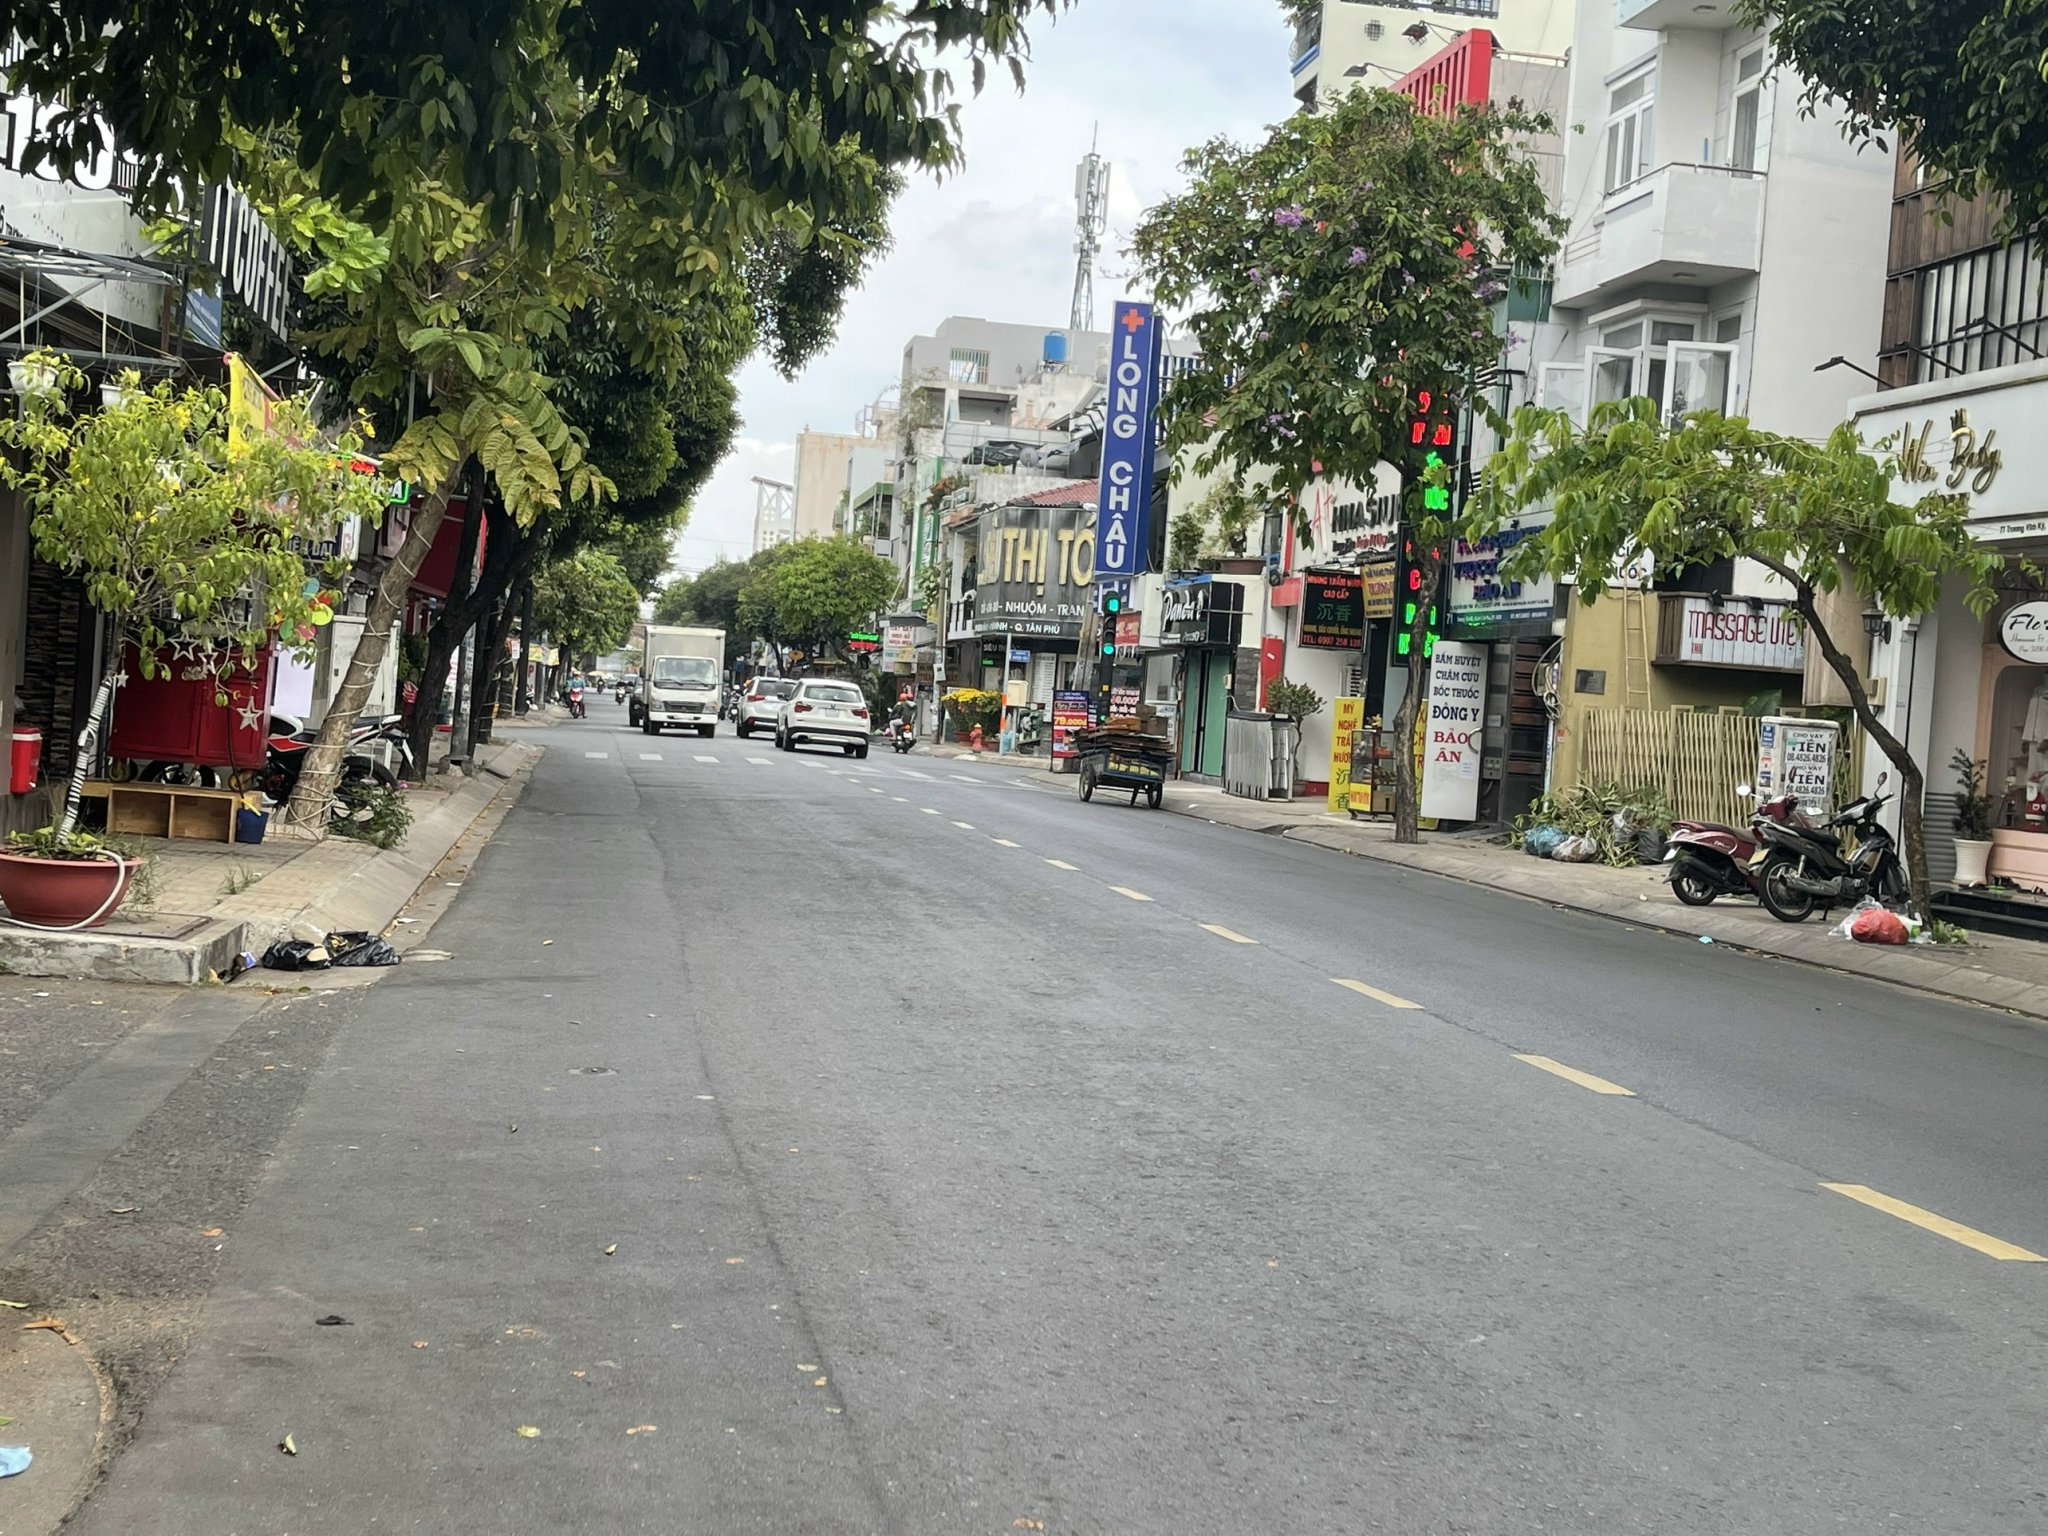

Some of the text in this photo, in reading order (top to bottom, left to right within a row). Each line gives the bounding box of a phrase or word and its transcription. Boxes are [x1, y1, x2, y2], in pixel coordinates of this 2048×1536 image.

[1112, 335, 1142, 439] LONG
[1105, 461, 1134, 569] CHÂU
[1003, 527, 1049, 597] THỊ
[1005, 600, 1047, 616] NHUỘM
[1316, 602, 1352, 622] 沉香
[1026, 623, 1042, 632] TÂN
[1043, 624, 1060, 634] PHÚ
[1688, 610, 1767, 644] MASSAGE
[1435, 650, 1481, 667] BẤM HUYỆT
[1436, 669, 1459, 682] CHÂM
[1433, 682, 1480, 699] BỐC THUỐC
[1432, 702, 1480, 722] ĐÔNG Y
[1336, 734, 1351, 747] TRẦ
[1433, 728, 1468, 744] BẢO
[1788, 738, 1826, 753] IỀN
[1333, 751, 1352, 763] HƯƠ
[1435, 747, 1462, 763] ÂN
